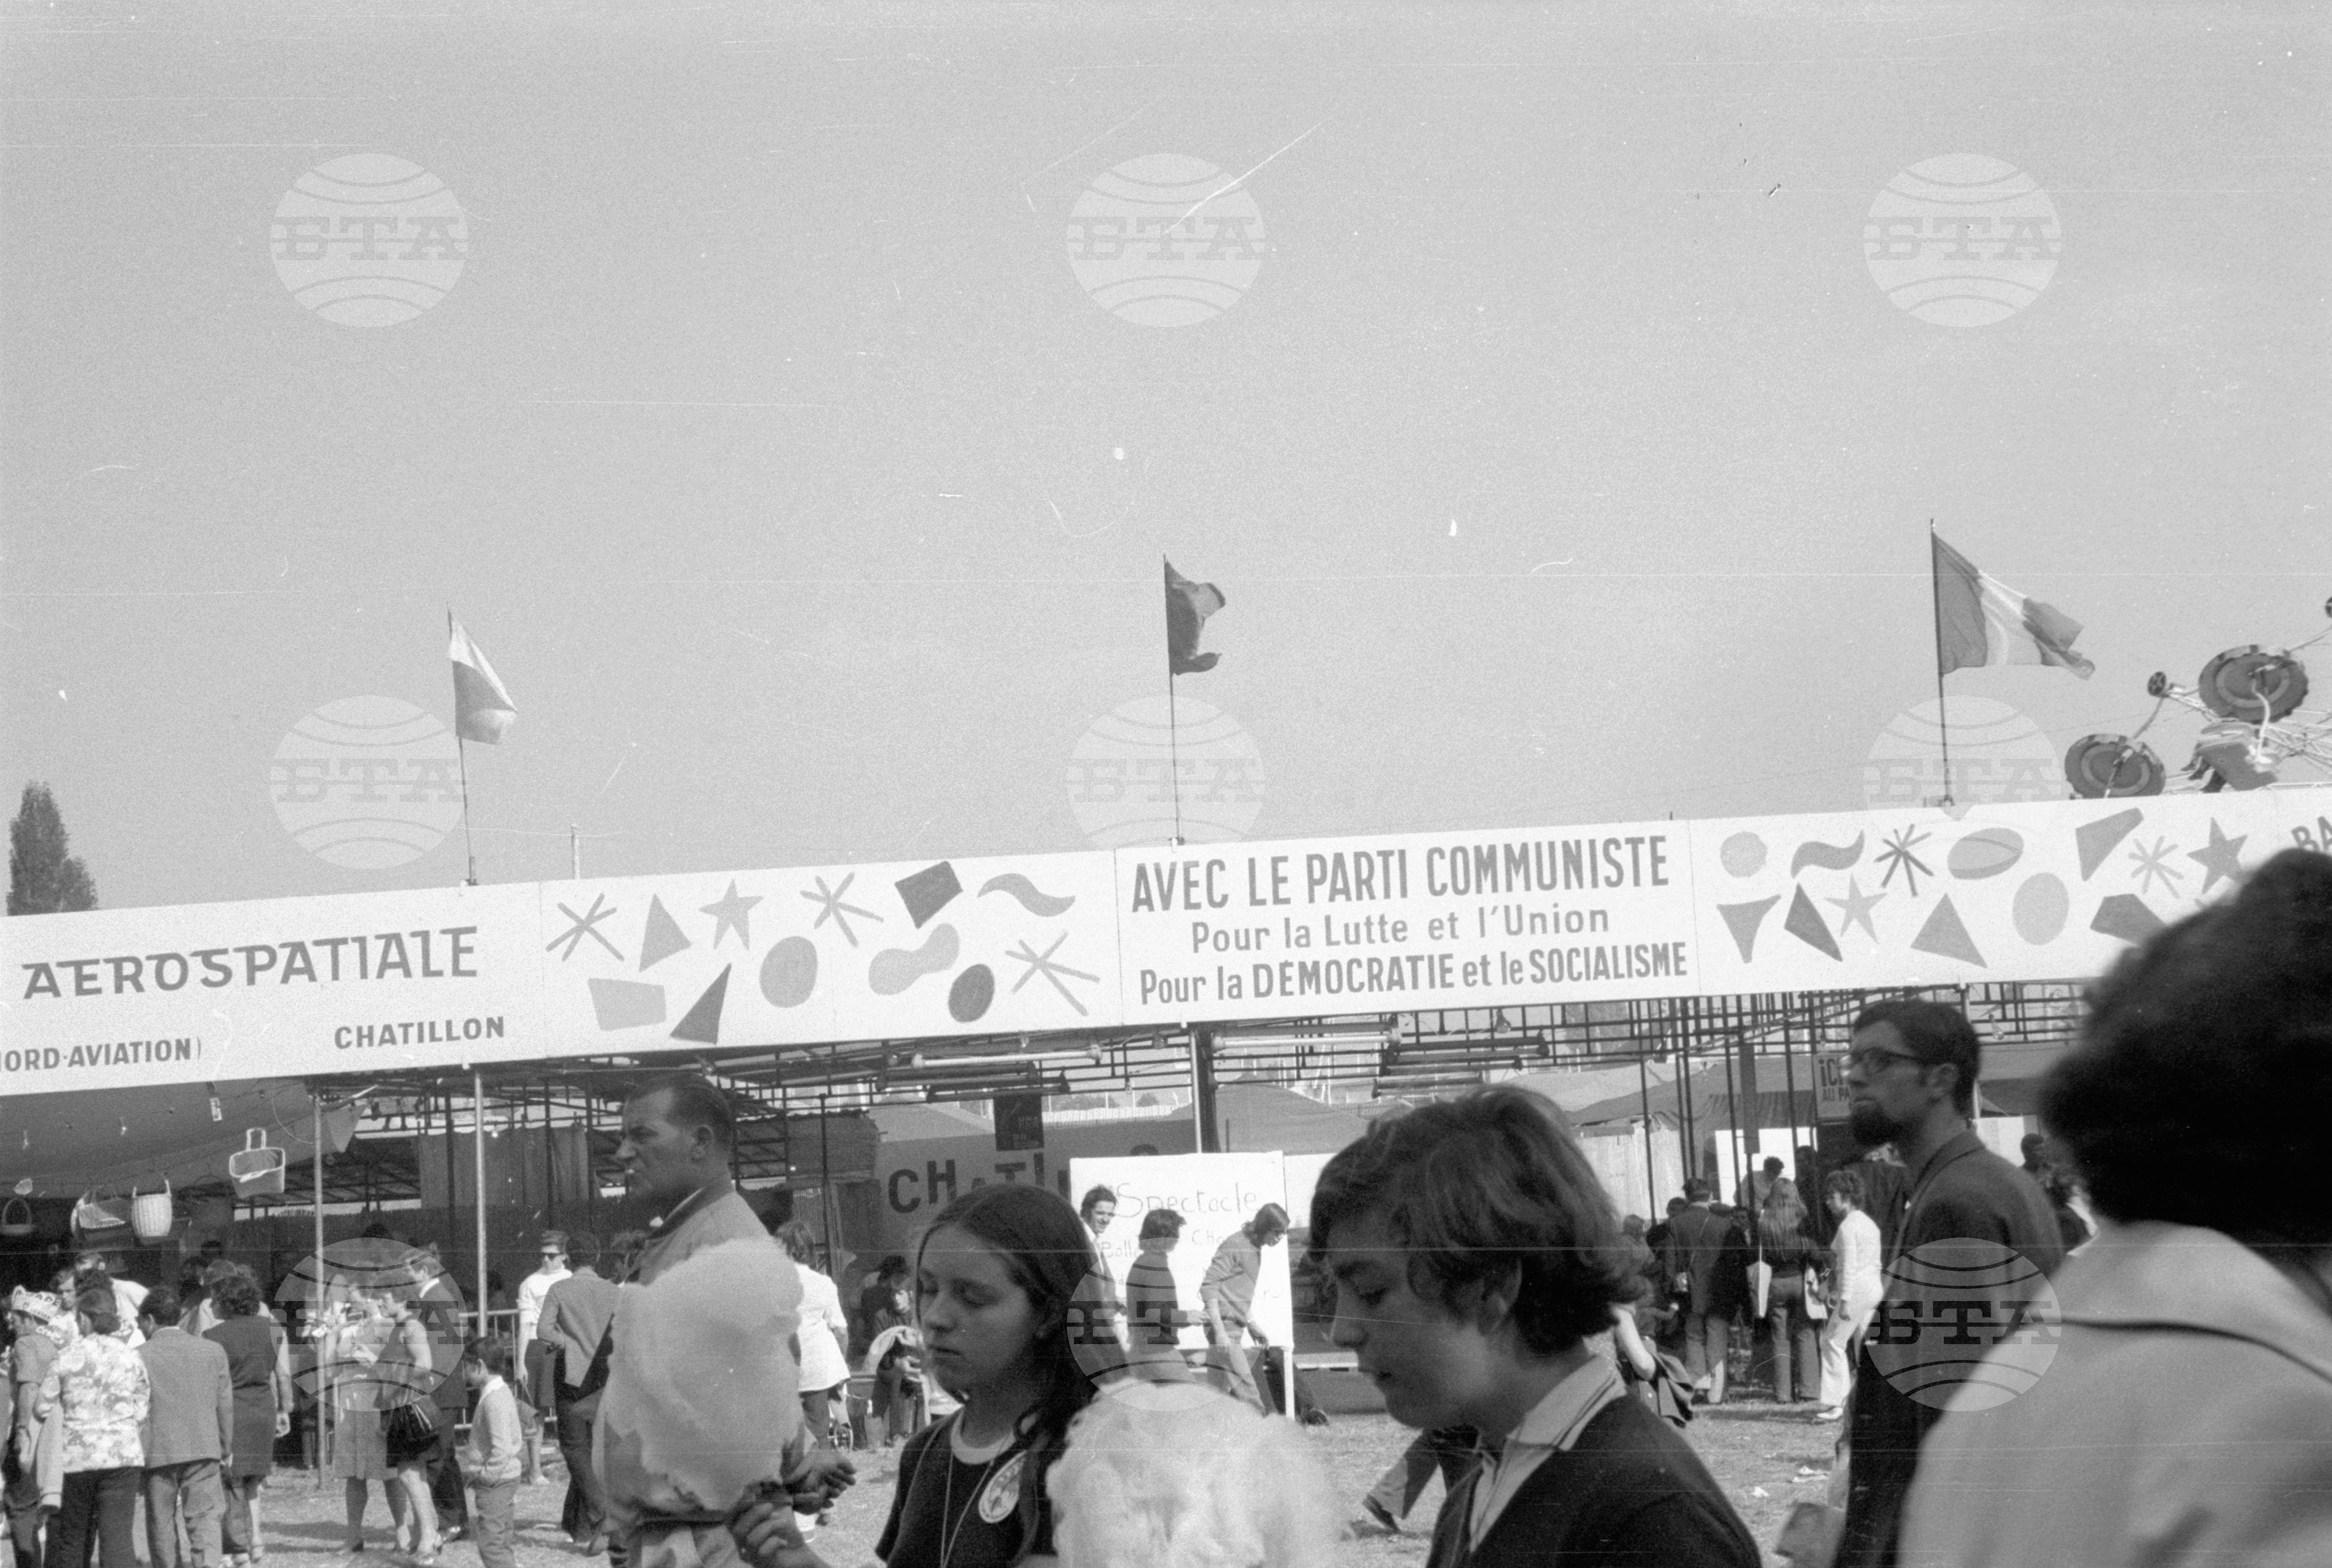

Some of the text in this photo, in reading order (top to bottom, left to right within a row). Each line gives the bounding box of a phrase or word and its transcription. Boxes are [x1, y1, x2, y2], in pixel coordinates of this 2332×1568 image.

[1133, 836, 1668, 912] AVEC LE PARTI COMMUNISTE
[1193, 922, 1270, 952] Pour
[1284, 918, 1310, 947] la
[1325, 915, 1407, 945] Lutte
[1428, 913, 1458, 939] et
[21, 926, 477, 999] AEROSPATIALE
[1140, 964, 1206, 1004] Pour
[1217, 966, 1242, 1000] la
[1462, 955, 1491, 986] et
[1501, 952, 1523, 985] le
[1529, 943, 1686, 983] SOCIALISME
[334, 1017, 504, 1049] CHATILLON
[1116, 1182, 1258, 1218] Spectacle
